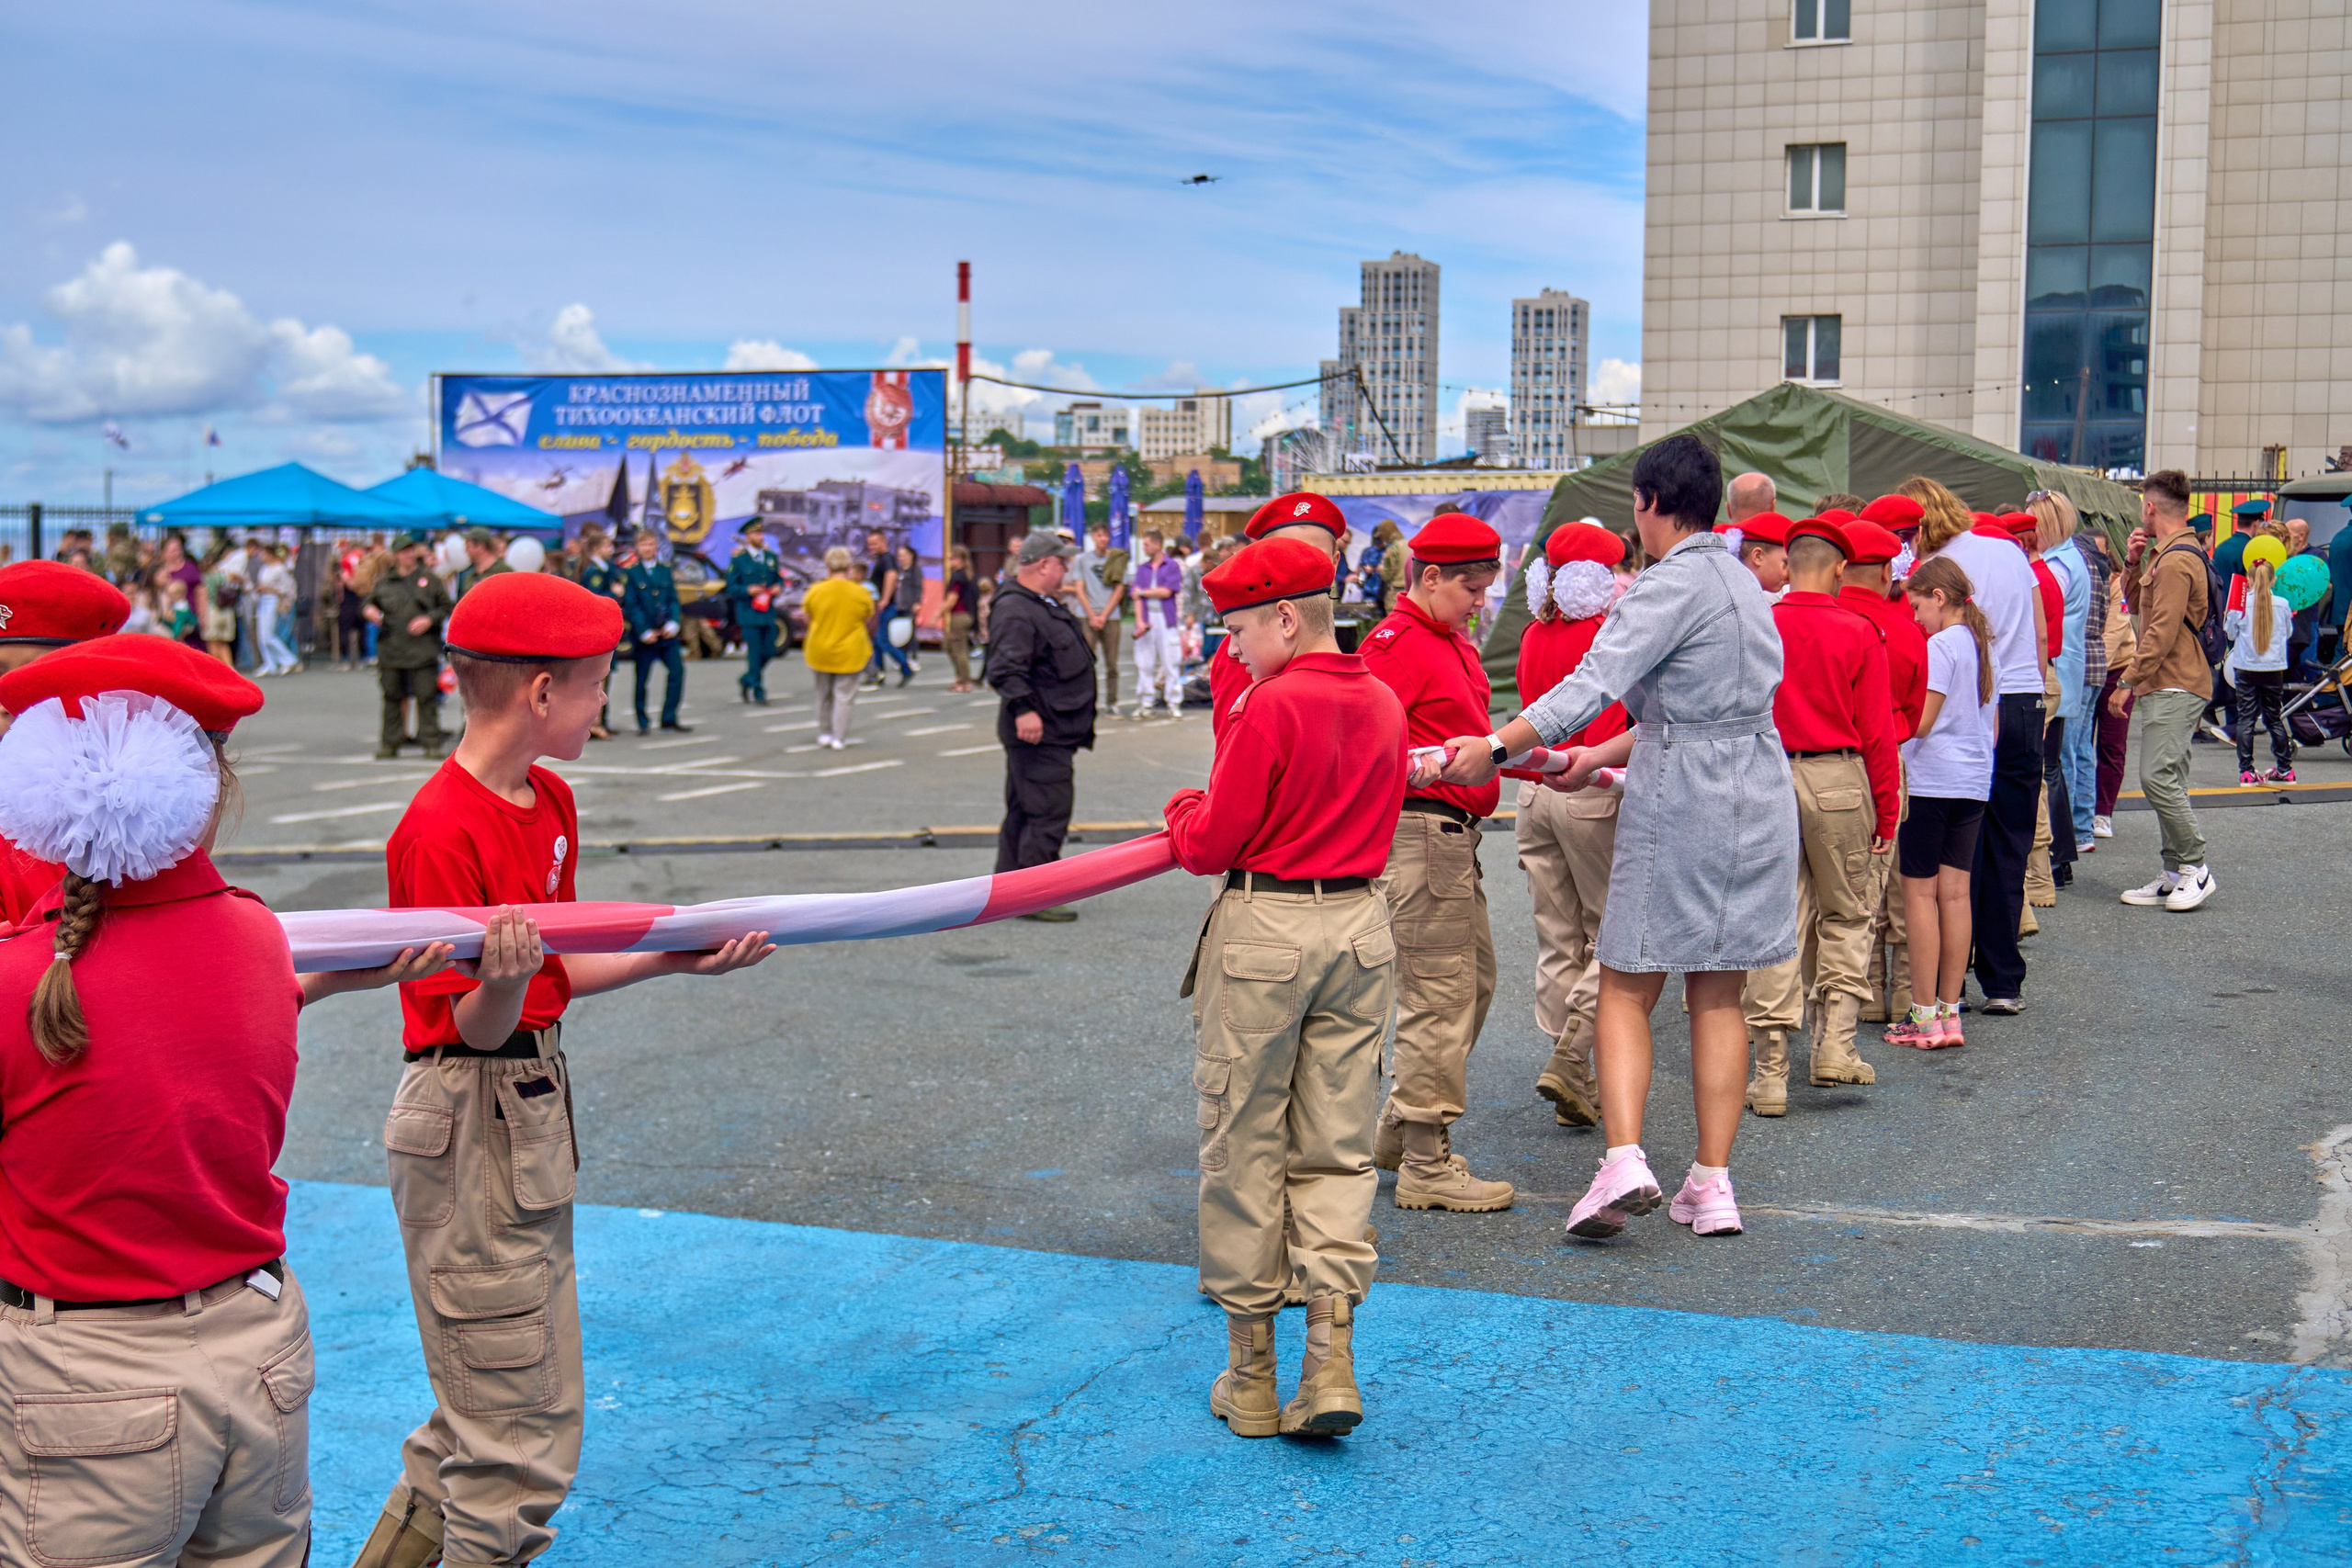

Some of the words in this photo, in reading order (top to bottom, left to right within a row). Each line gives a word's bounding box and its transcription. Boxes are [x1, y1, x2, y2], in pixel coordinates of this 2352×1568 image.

[568, 379, 810, 404] КРАСНОЗНАМЕННЫЙ
[554, 400, 756, 425] ТИХООКЕАНСКИЙ
[758, 404, 824, 424] ФЛОТ
[538, 434, 601, 449] слава
[627, 429, 734, 453] гордость
[757, 427, 839, 447] победа
